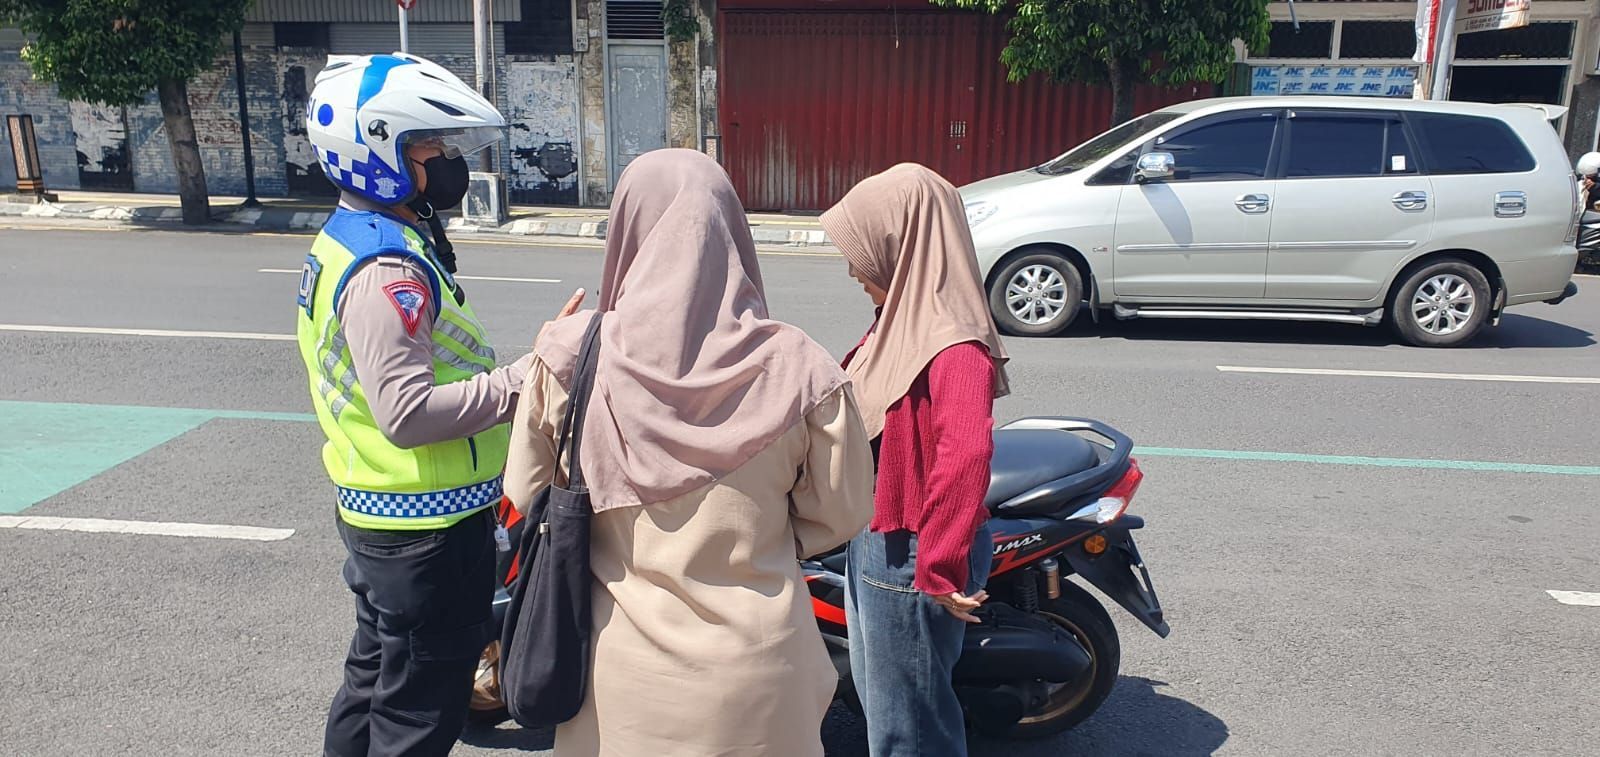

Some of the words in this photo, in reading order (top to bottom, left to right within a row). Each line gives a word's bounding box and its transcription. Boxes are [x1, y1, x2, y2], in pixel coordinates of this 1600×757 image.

[1468, 0, 1525, 14] SUMB
[1363, 67, 1384, 76] JNE
[1360, 82, 1381, 91] JNE
